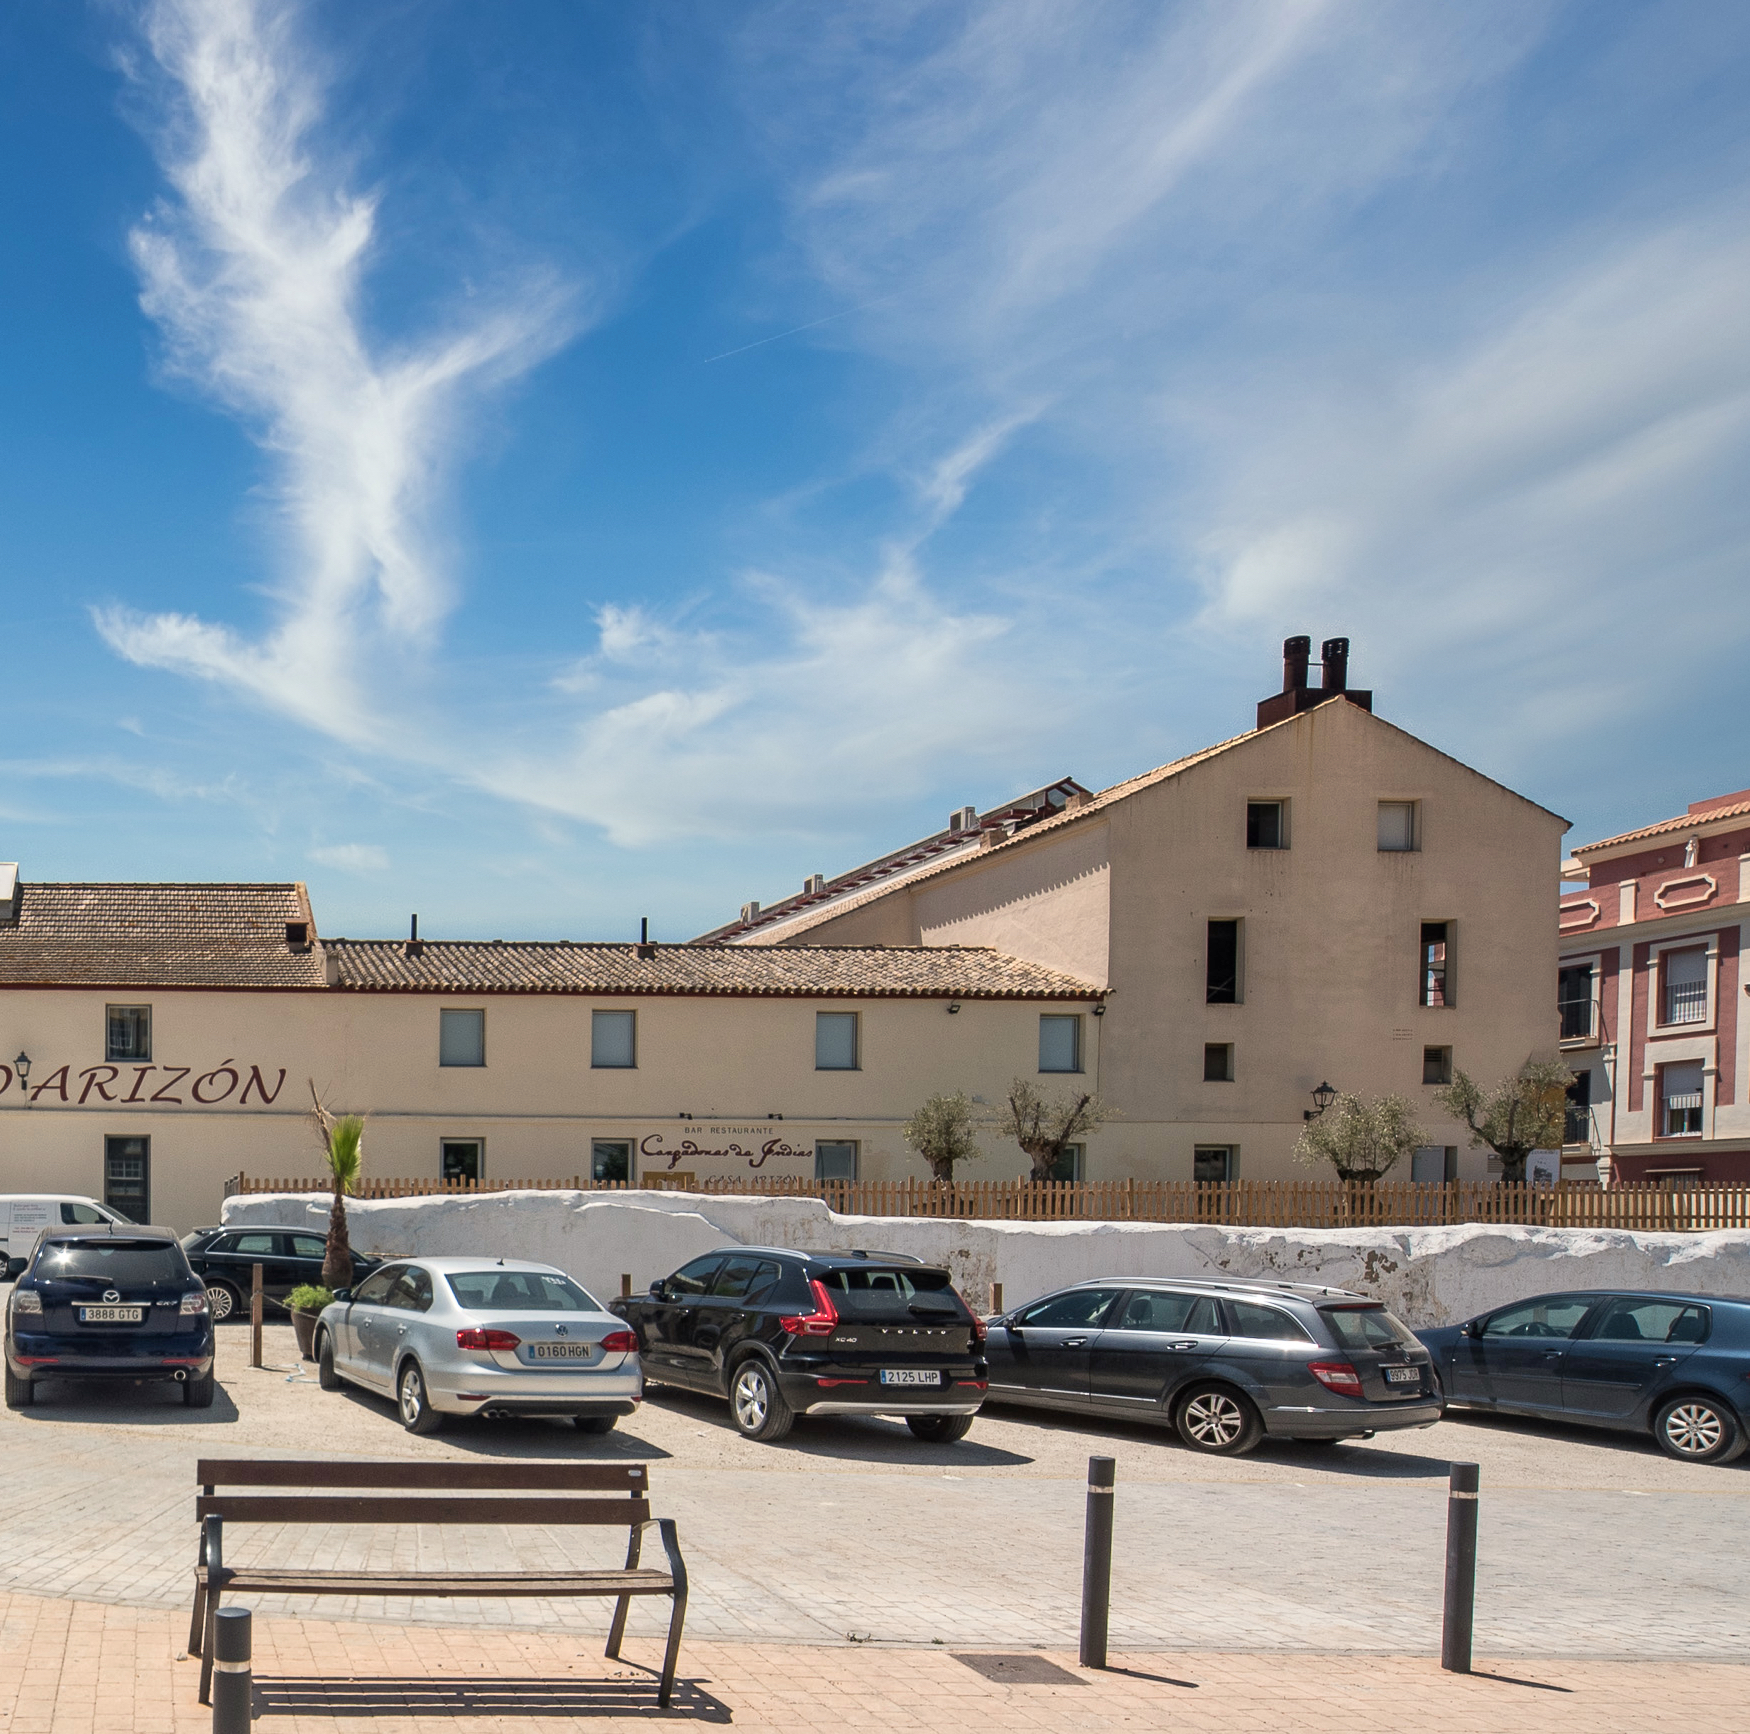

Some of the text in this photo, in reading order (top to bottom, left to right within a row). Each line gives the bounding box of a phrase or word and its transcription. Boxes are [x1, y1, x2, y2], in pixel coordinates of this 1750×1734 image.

[30, 1058, 287, 1105] ARIZÓN
[684, 1126, 774, 1135] BAR RESTAURANTE
[88, 1310, 139, 1320] 3888 GTG
[537, 1345, 589, 1357] 0160 HGN
[888, 1371, 938, 1383] 2125 LHP
